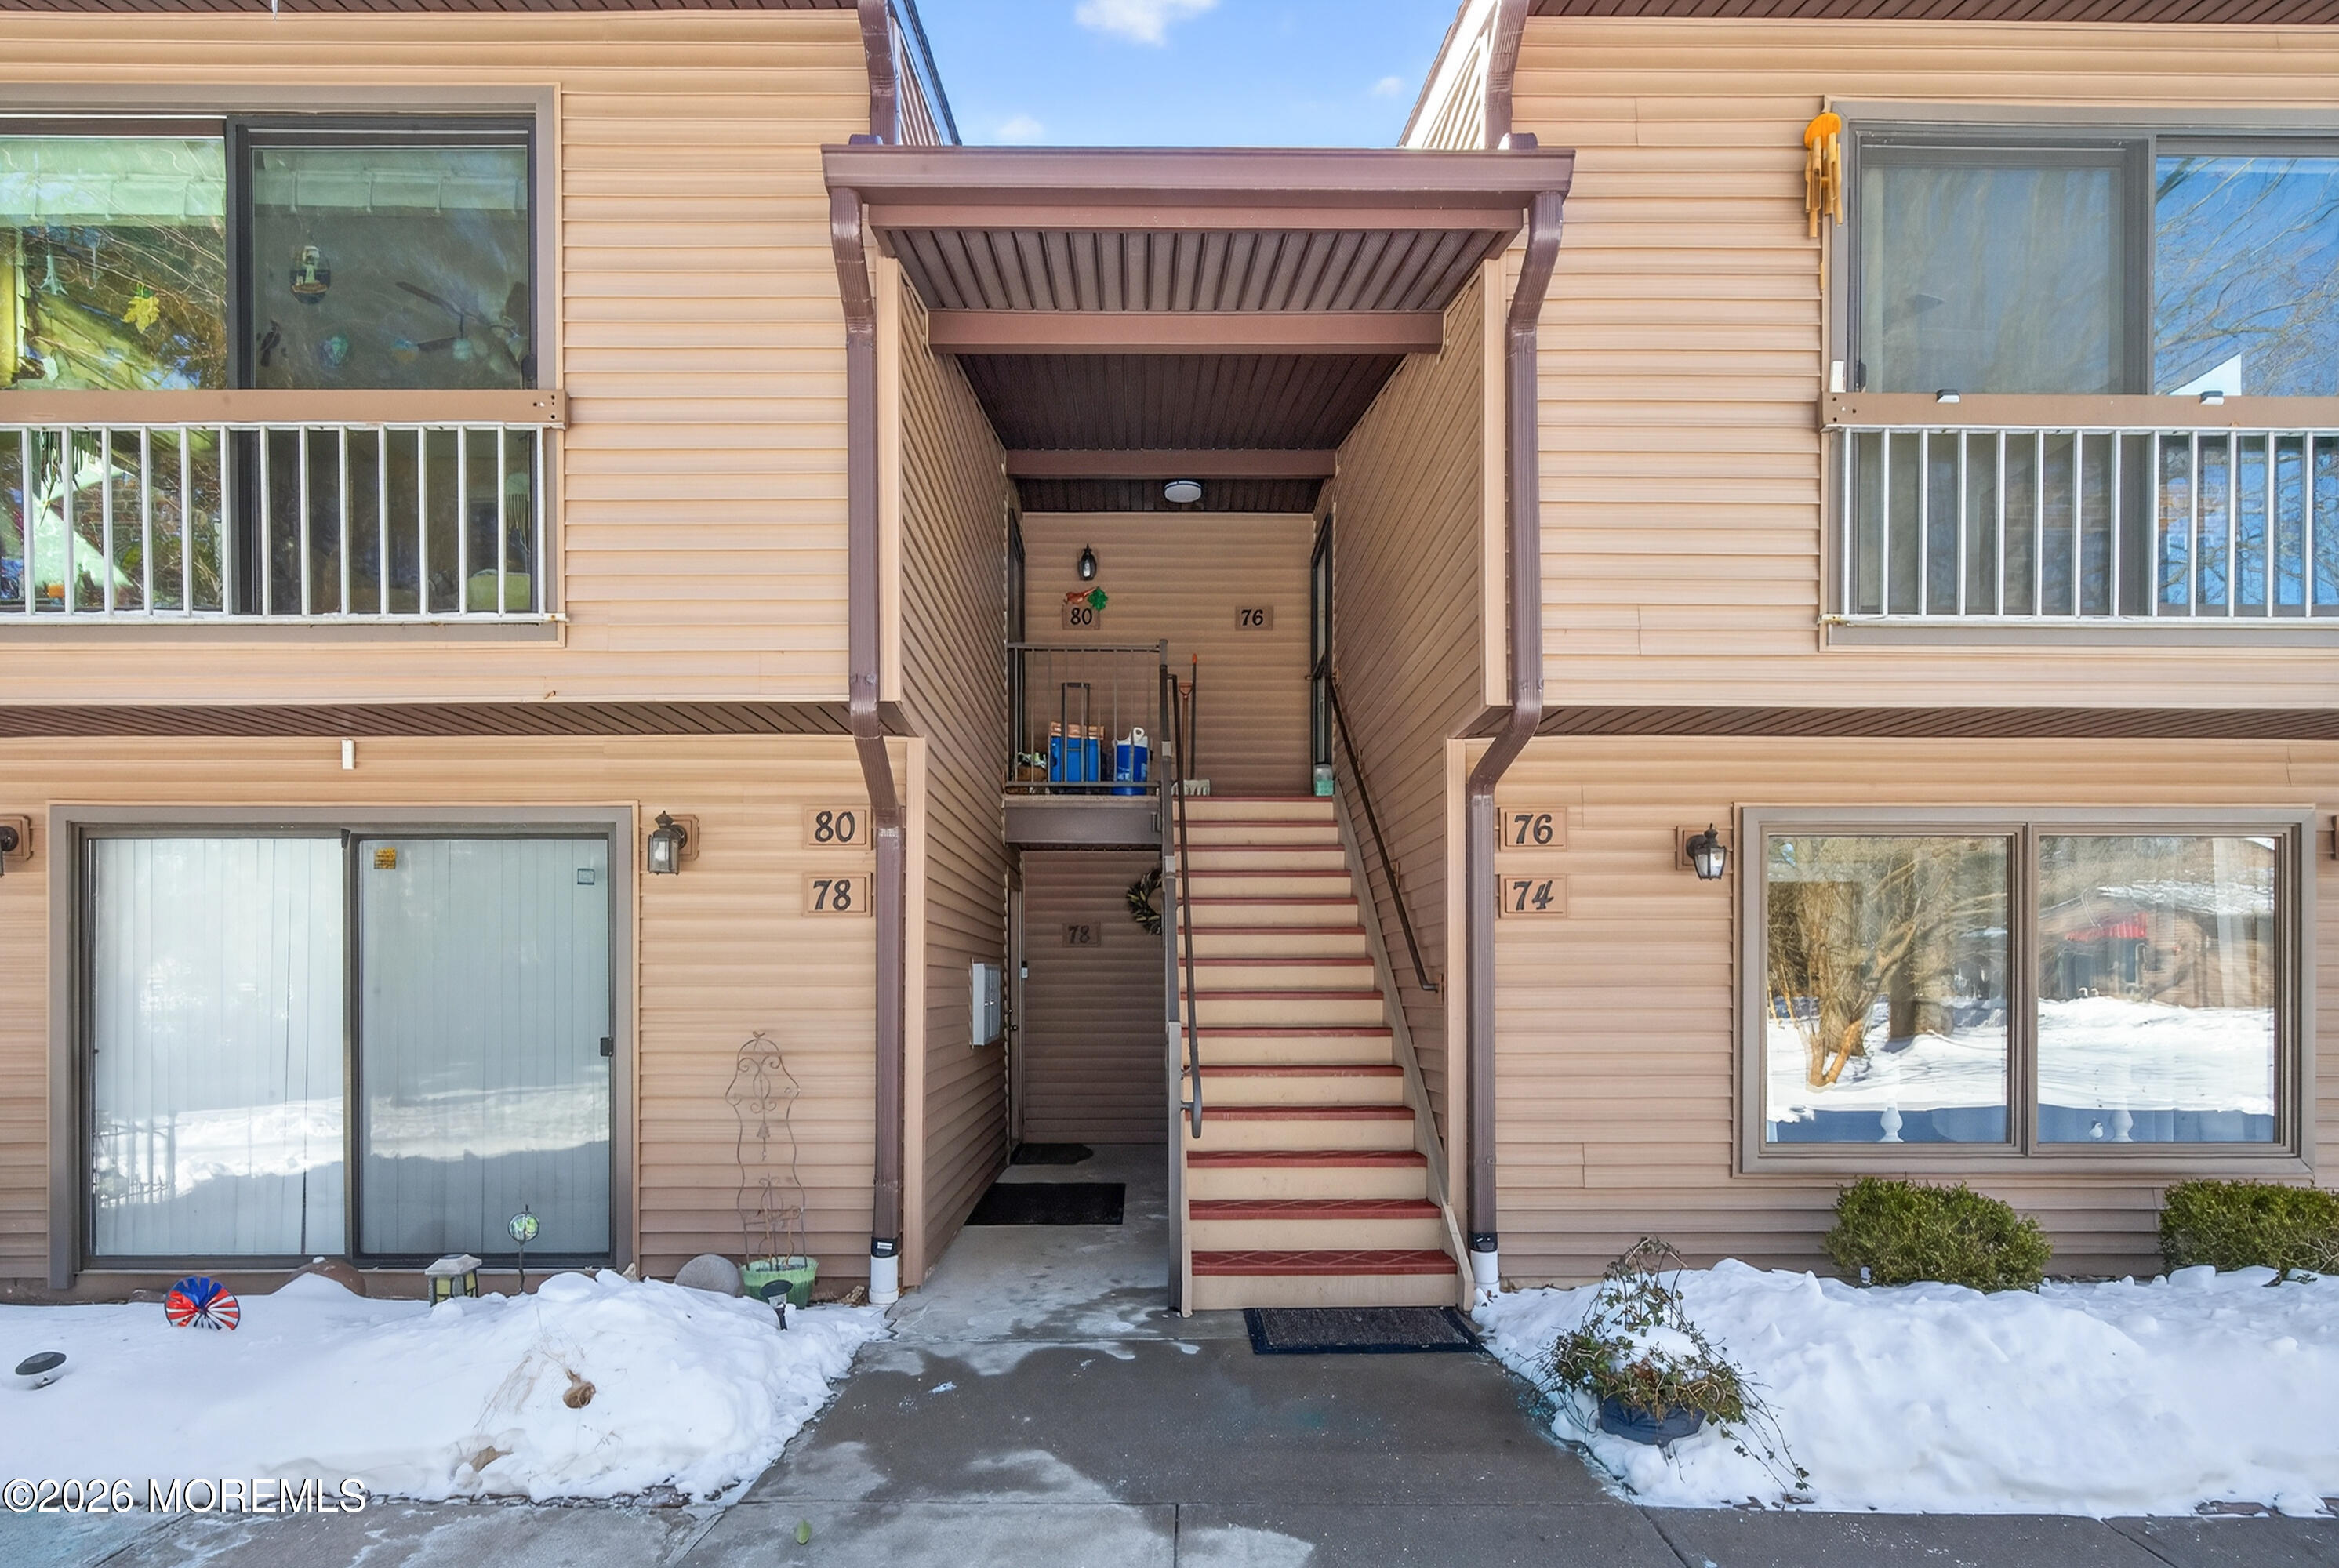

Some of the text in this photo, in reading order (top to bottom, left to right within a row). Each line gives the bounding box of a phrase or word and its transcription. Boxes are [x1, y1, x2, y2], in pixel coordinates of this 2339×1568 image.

[1070, 608, 1092, 625] 80
[1241, 608, 1264, 626] 76
[815, 811, 855, 842] 80
[1514, 814, 1553, 844] 76
[813, 880, 852, 911] 78
[1513, 880, 1554, 911] 74
[1068, 925, 1090, 944] 78
